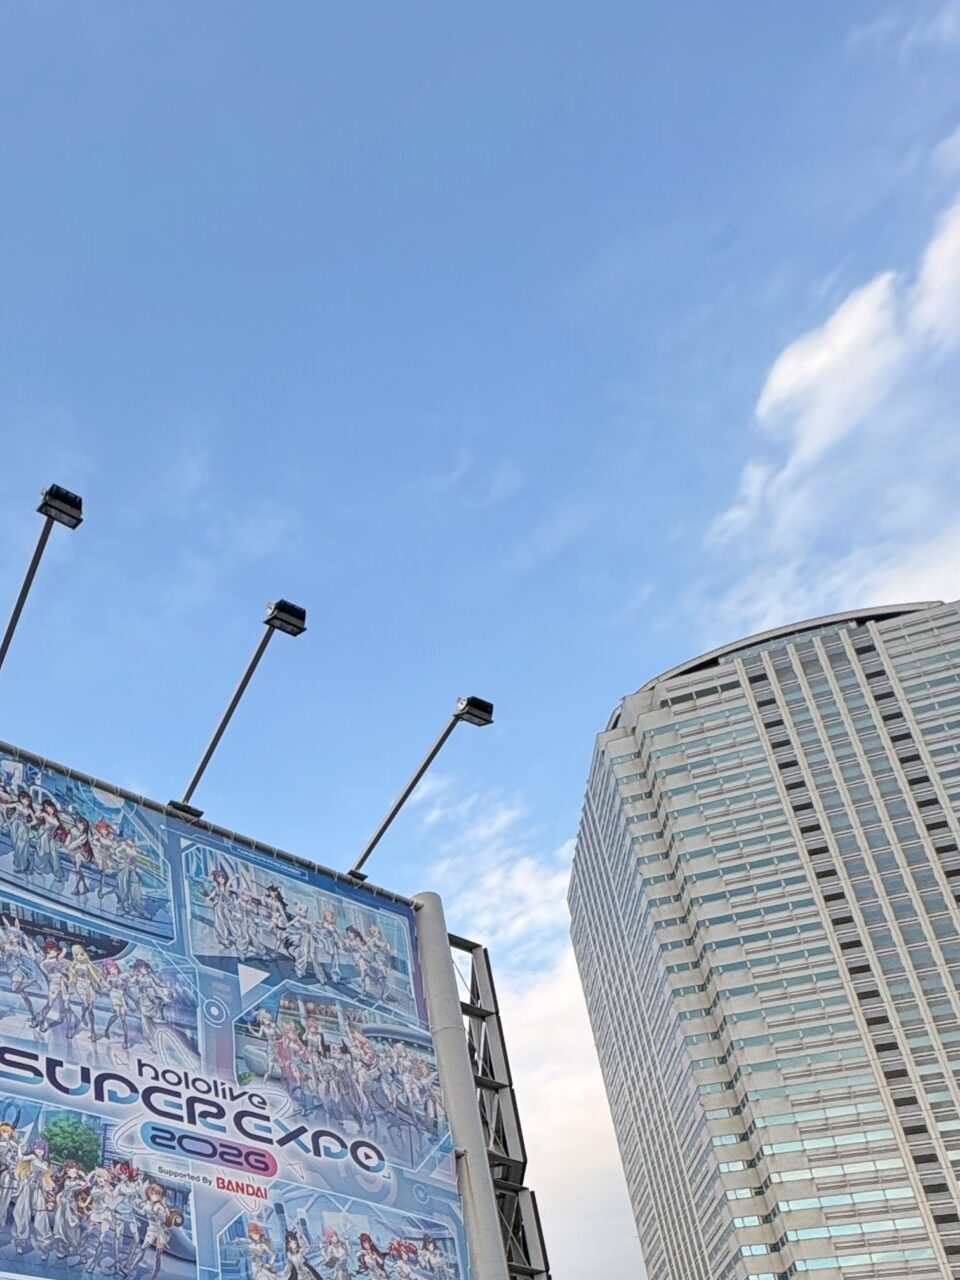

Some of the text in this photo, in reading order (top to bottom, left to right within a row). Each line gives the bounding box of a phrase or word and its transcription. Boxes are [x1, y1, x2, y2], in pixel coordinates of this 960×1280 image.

[137, 1058, 268, 1110] hololive
[149, 1125, 271, 1173] 2026
[233, 1110, 386, 1173] EXPO
[157, 1166, 269, 1200] Supported By BANDAI
